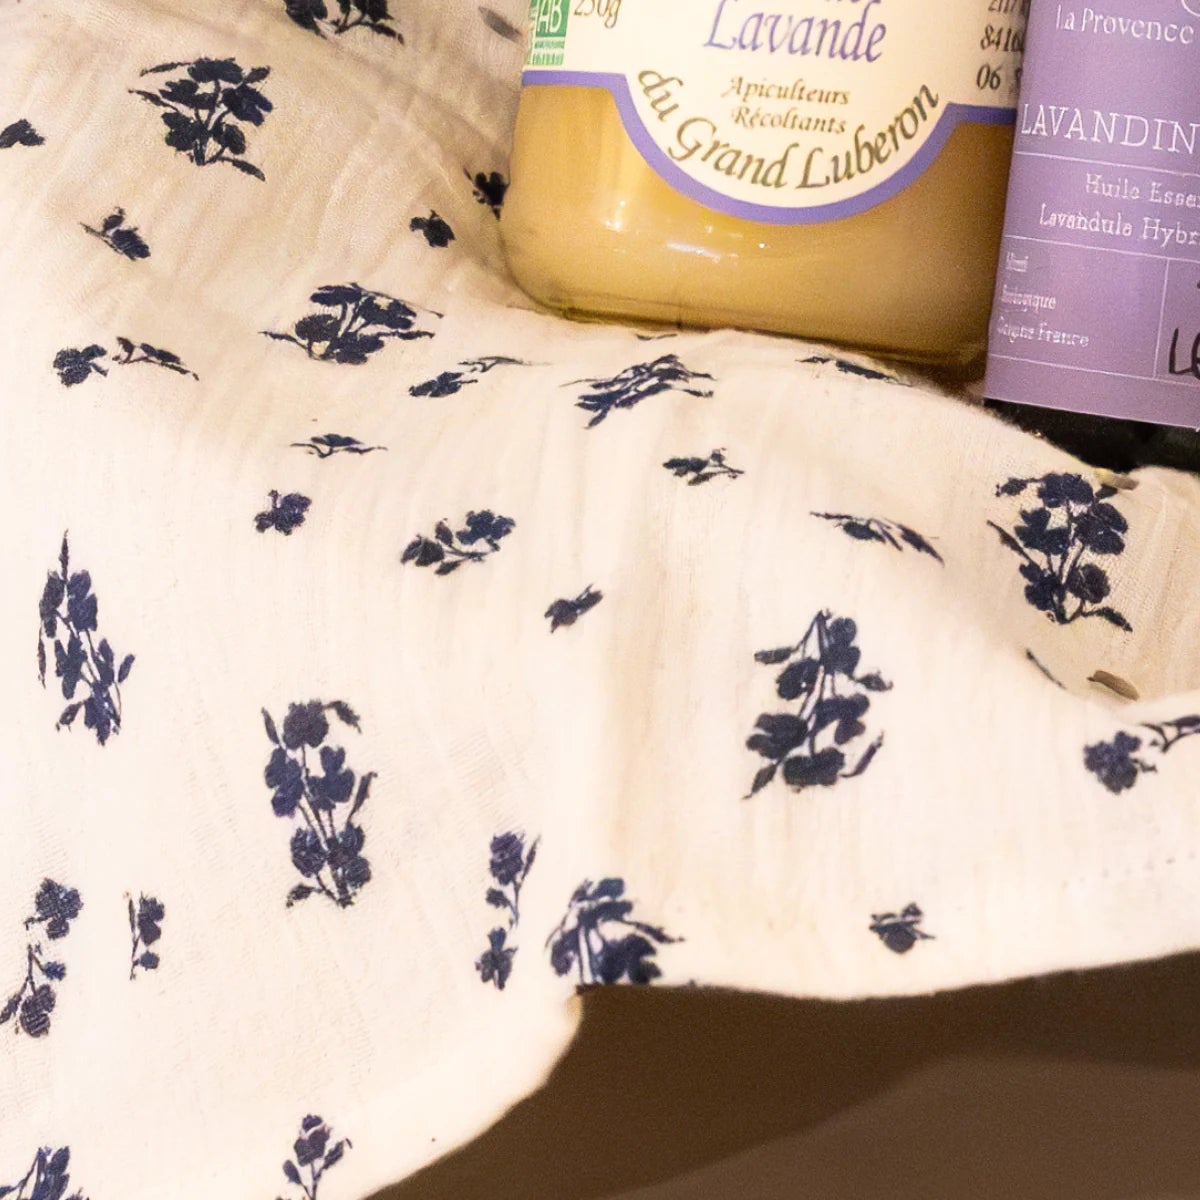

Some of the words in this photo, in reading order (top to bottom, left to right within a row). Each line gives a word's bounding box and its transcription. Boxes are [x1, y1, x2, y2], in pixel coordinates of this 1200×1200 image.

[1081, 7, 1195, 45] Provence
[721, 75, 851, 105] Apiculteurs
[976, 63, 1002, 90] 06
[638, 69, 684, 122] du
[668, 116, 800, 189] Grand
[795, 83, 940, 189] Luberon
[731, 105, 847, 135] Récoltants
[1020, 103, 1200, 155] LAVANDIN
[1086, 173, 1140, 200] Huile
[1038, 202, 1133, 237] Lavandula
